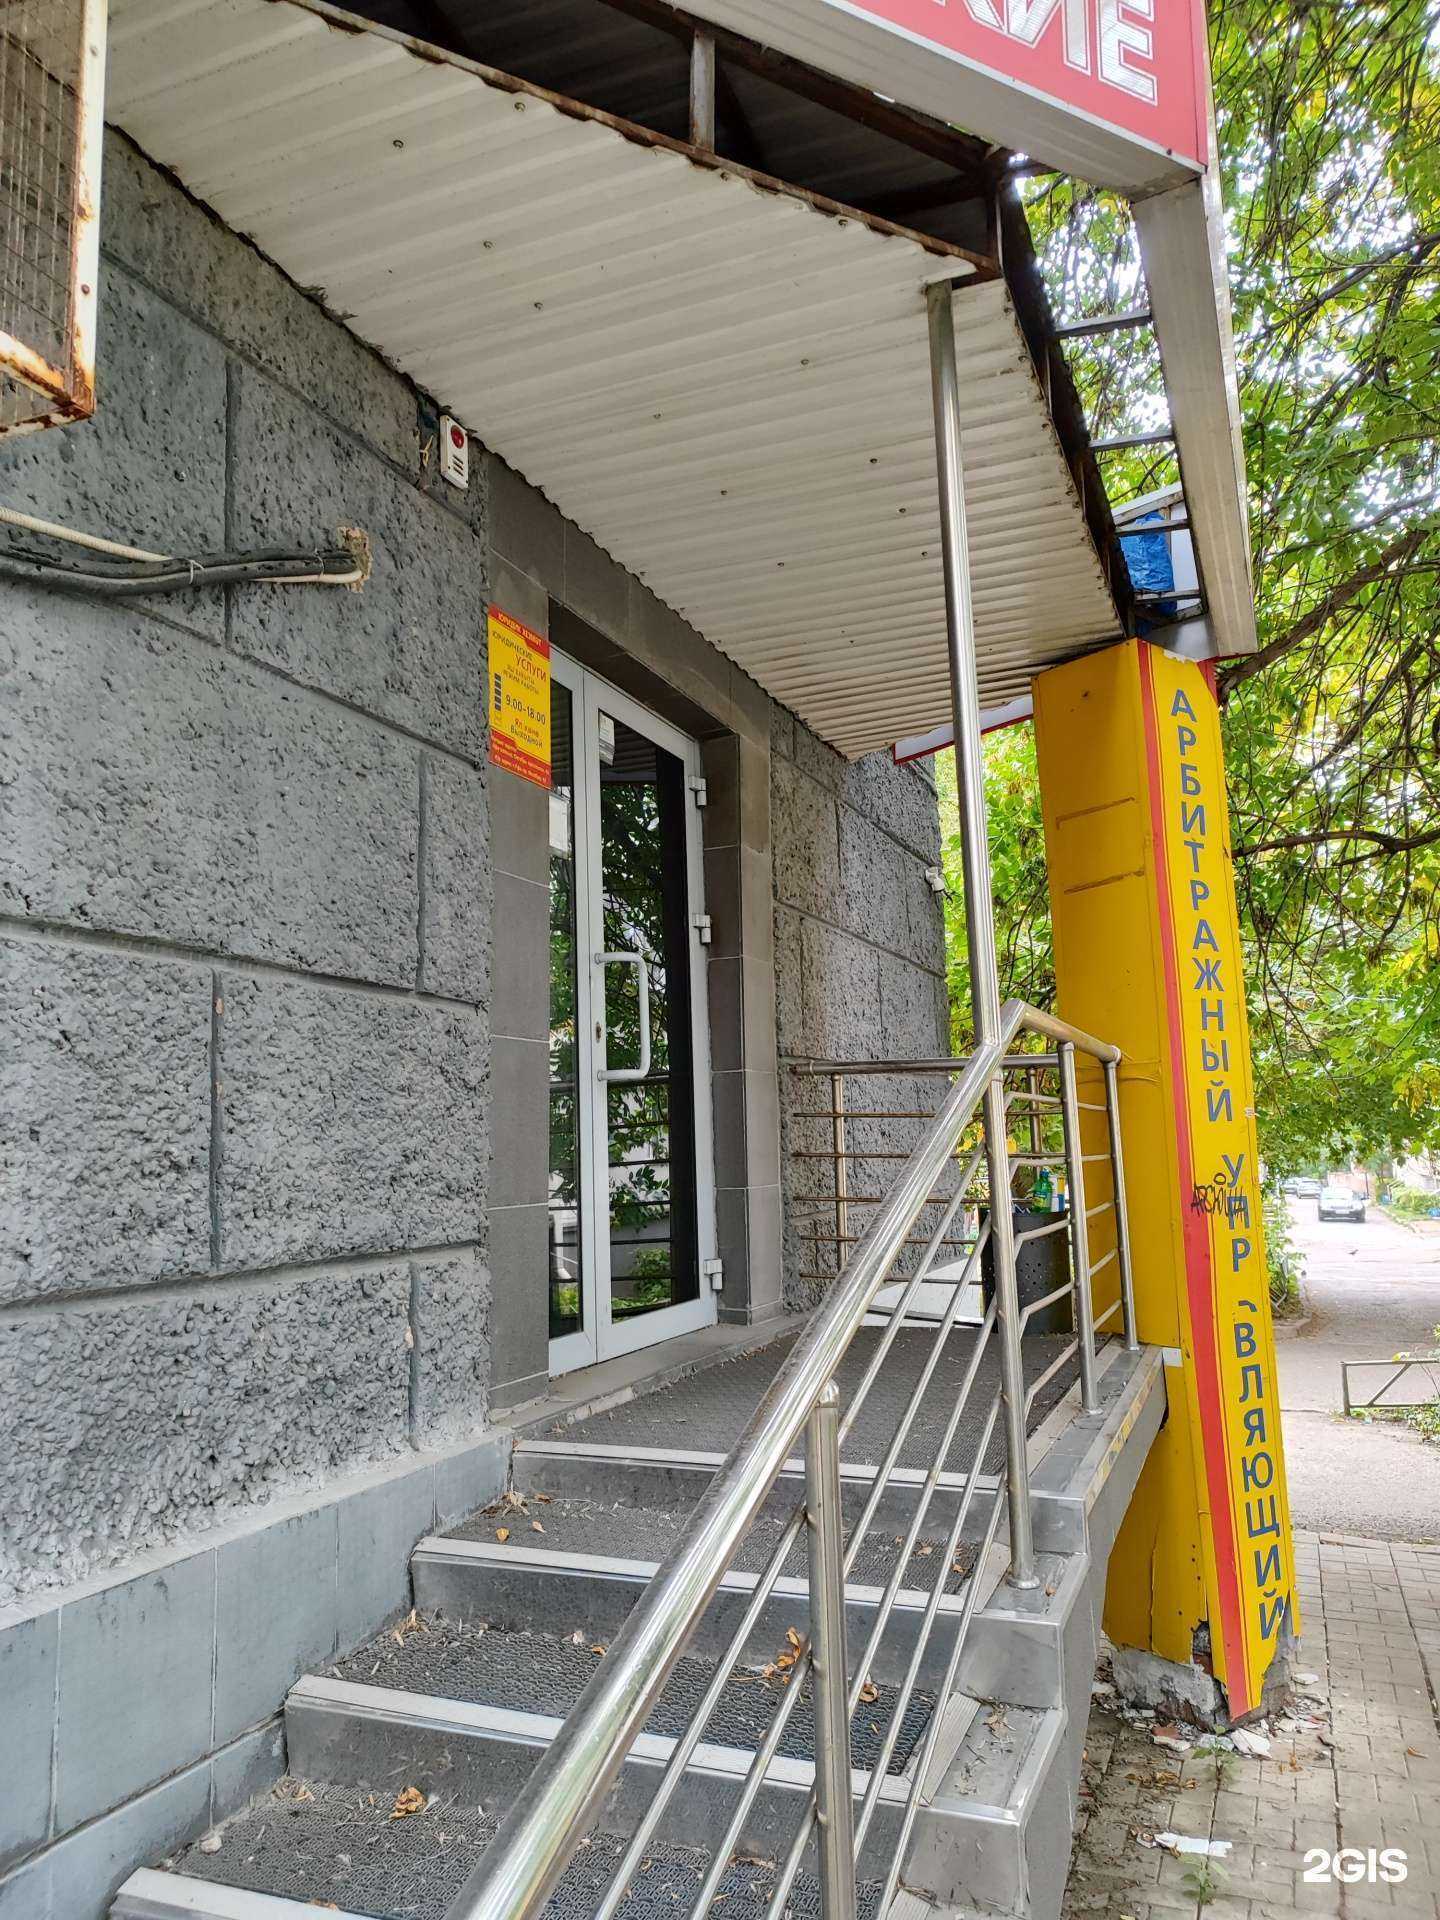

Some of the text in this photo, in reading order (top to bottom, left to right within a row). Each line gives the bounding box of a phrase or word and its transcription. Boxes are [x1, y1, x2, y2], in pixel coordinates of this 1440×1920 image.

[492, 631, 533, 661] ЮРИДИЧЕСКИЕ
[515, 654, 547, 682] УСЛУГИ
[1171, 688, 1233, 1123] АРБИТРАЖНЫЙ
